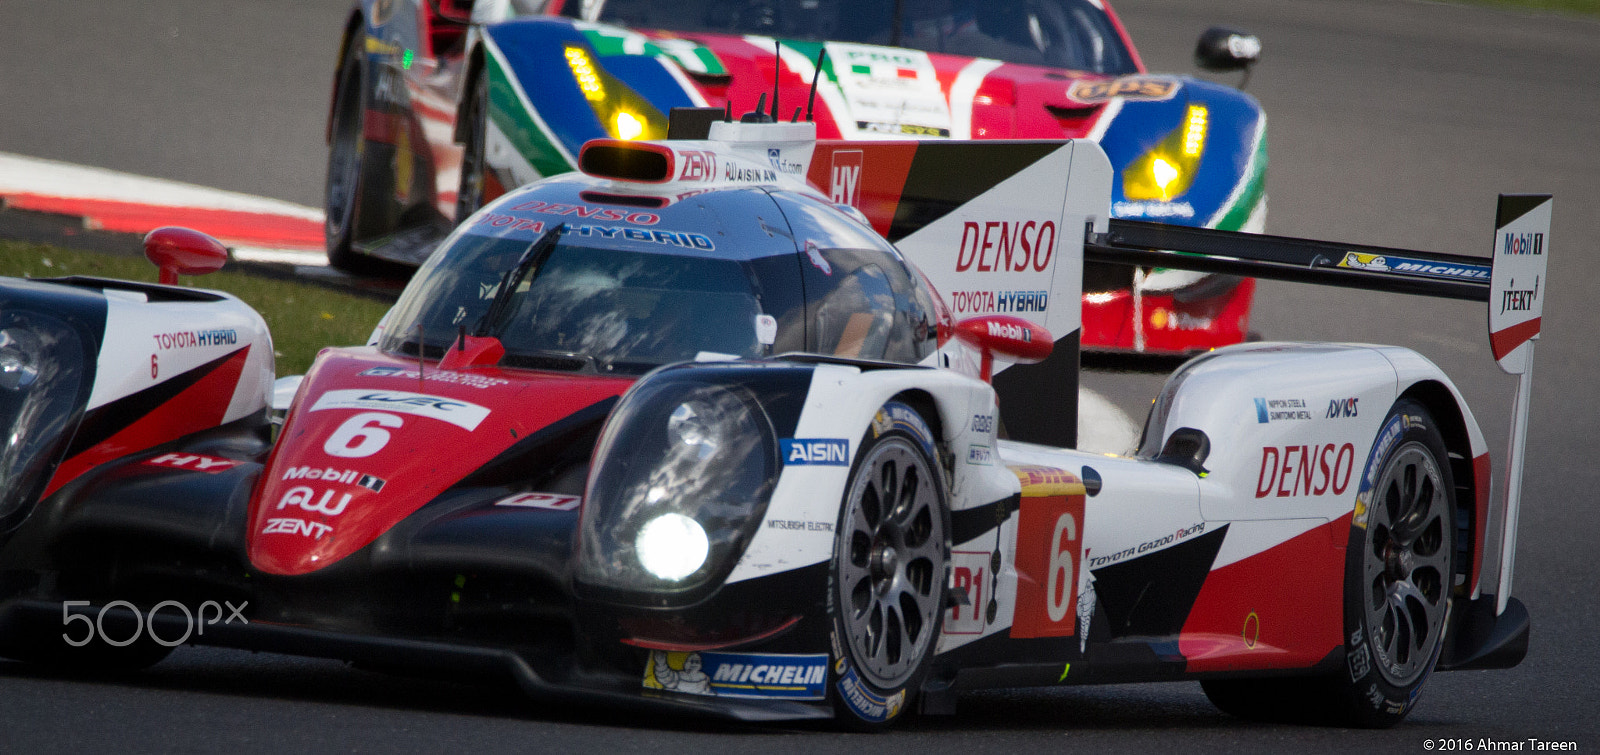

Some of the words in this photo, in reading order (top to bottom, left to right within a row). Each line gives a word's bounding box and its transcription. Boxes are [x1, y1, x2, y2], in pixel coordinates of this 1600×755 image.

[678, 150, 717, 182] ZENT
[738, 168, 761, 182] AISIN
[763, 169, 777, 182] AW
[833, 165, 860, 207] HY
[509, 200, 661, 226] DENSO
[558, 222, 716, 251] HYBRID
[955, 220, 1056, 273] DENSO
[1504, 232, 1533, 256] Mobil
[1534, 232, 1544, 256] 1
[952, 291, 995, 313] TOYOTA
[997, 290, 1048, 312] HYBRID
[1501, 288, 1533, 316] JTEKT
[154, 332, 197, 351] TOYOTA
[198, 328, 237, 346] HYBRID
[987, 321, 1022, 341] Mobil
[151, 354, 158, 380] 6
[1268, 400, 1286, 409] NIPPON
[1287, 399, 1301, 408] STEEL
[1269, 411, 1295, 421] SUMITOMO
[1296, 410, 1312, 420] METAL
[323, 411, 404, 458] 6
[148, 453, 234, 470] HY
[789, 443, 846, 462] AISIN
[1367, 419, 1401, 484] MICHELIN
[281, 466, 358, 485] Mobil
[1255, 443, 1355, 499] DENSO
[262, 518, 332, 538] ZENT
[767, 519, 806, 530] MITSUBISHI
[807, 521, 834, 532] ELECTRIC
[1089, 547, 1136, 568] TOYOTA
[1137, 534, 1175, 554] GAZOO
[1175, 521, 1206, 541] Racing
[1046, 512, 1077, 622] 6
[952, 566, 983, 621] P1
[713, 663, 827, 685] MICHELIN
